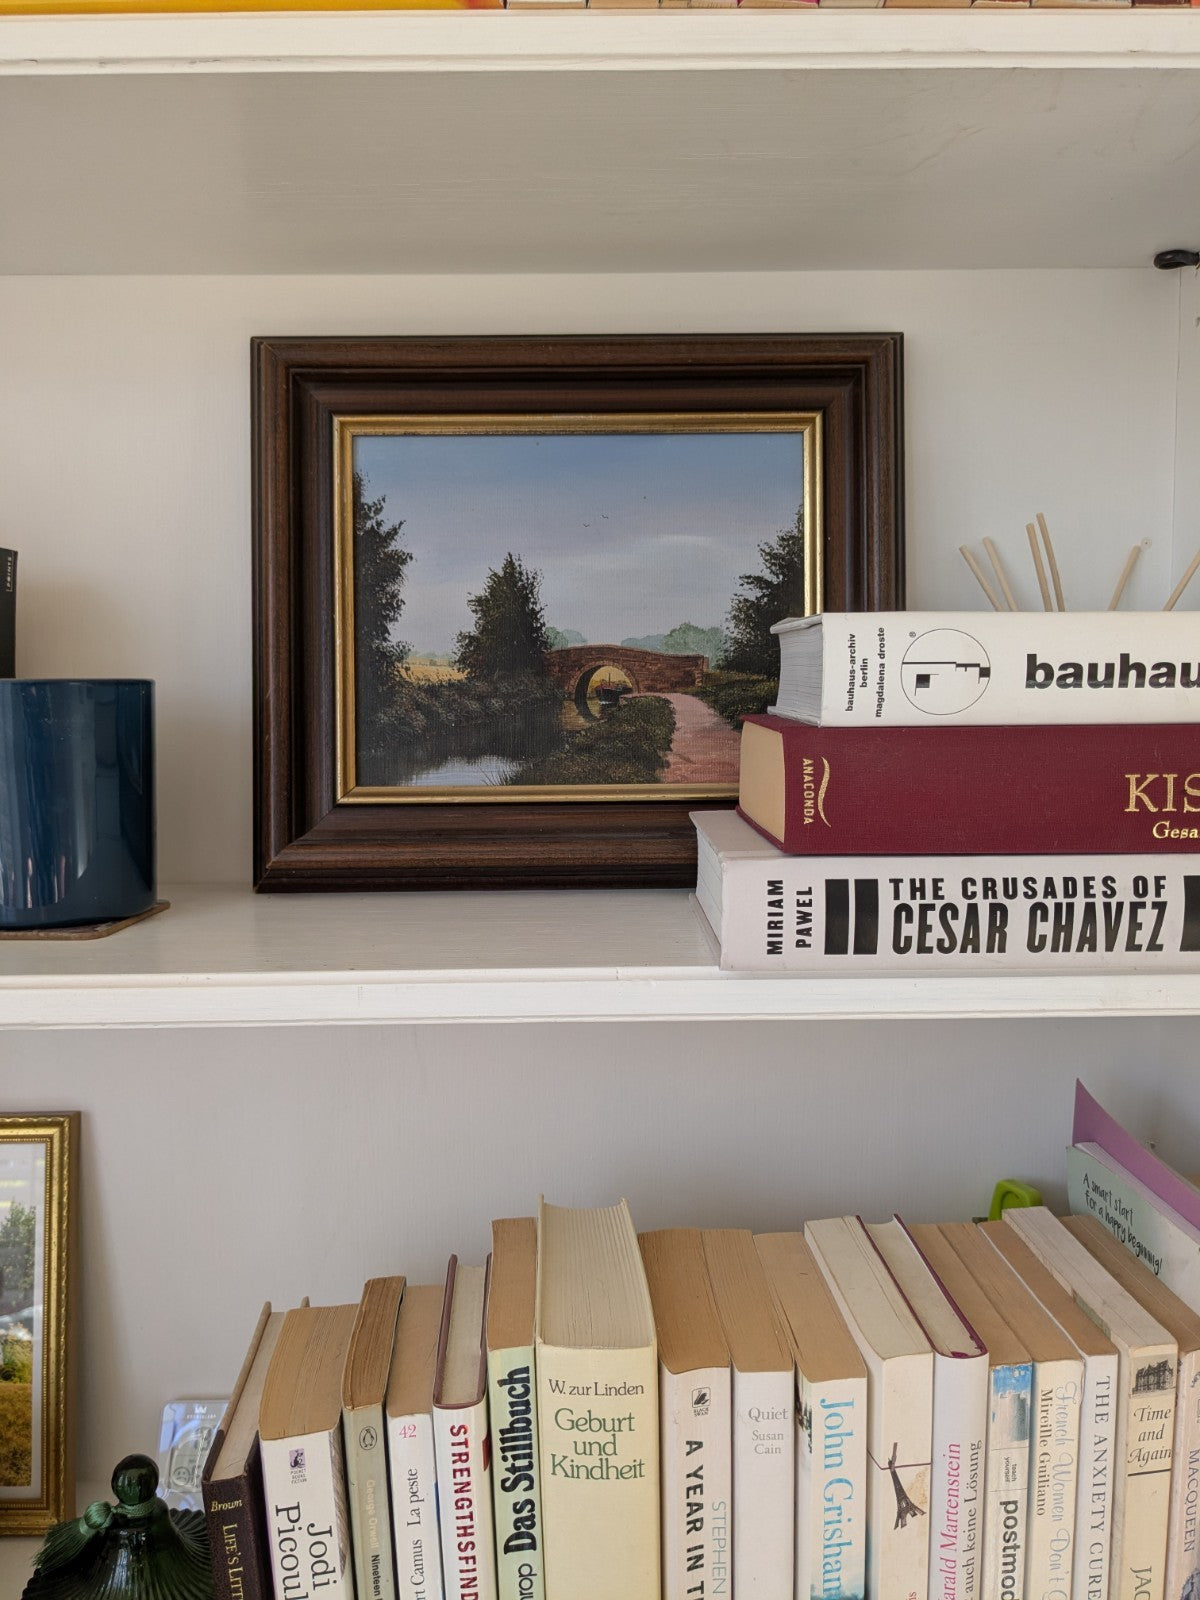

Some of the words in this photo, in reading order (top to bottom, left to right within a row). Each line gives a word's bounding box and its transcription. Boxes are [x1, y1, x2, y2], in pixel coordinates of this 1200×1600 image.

[845, 633, 856, 712] bauhaus-archiv
[859, 657, 869, 688] berlin
[875, 663, 886, 718] magdalena
[802, 757, 815, 825] ANACONDA
[1124, 773, 1200, 813] KIS
[889, 878, 945, 901] THE
[961, 875, 1117, 899] CRUSADES
[1132, 875, 1167, 898] OF
[766, 879, 784, 955] MIRIAM
[795, 886, 813, 949] PAWEL
[892, 902, 1009, 955] CESAR
[1026, 901, 1168, 953] CHAVEZ
[1083, 1172, 1090, 1188] A
[1091, 1181, 1112, 1208] smart
[1114, 1197, 1133, 1227] start
[1085, 1190, 1097, 1211] for
[1098, 1207, 1104, 1219] a
[1105, 1205, 1126, 1243] happy
[548, 1379, 566, 1395] W.
[568, 1385, 592, 1396] zur
[594, 1381, 644, 1396] Linden
[1094, 1375, 1111, 1424] THE
[399, 1424, 417, 1439] 42
[497, 1366, 535, 1493] Stillbuch
[554, 1407, 636, 1433] Geburt
[748, 1406, 789, 1422] Quiet
[752, 1429, 784, 1441] Susan
[819, 1398, 855, 1471] John
[1039, 1387, 1053, 1448] Mireille
[1055, 1381, 1077, 1446] French
[1133, 1404, 1172, 1422] Time
[1138, 1423, 1165, 1442] and
[550, 1453, 646, 1480] Kindheit
[573, 1433, 618, 1456] und
[685, 1440, 704, 1457] A
[754, 1443, 782, 1455] Cain
[1127, 1446, 1173, 1468] Again
[407, 1468, 425, 1504] peste
[964, 1440, 982, 1503] Lösung
[1036, 1451, 1051, 1516] Guiliano
[1051, 1451, 1074, 1522] Women
[1090, 1434, 1108, 1532] ANXIETY
[210, 1499, 243, 1512] Brown
[366, 1480, 376, 1515] George
[407, 1508, 421, 1527] La
[686, 1464, 704, 1535] YEAR
[939, 1443, 961, 1552] Martenstein
[1183, 1449, 1200, 1553] MACQUEEN
[369, 1517, 379, 1549] Orwell
[503, 1498, 537, 1555] Das
[712, 1501, 727, 1594] STEPHEN
[962, 1508, 977, 1553] keine
[307, 1522, 337, 1591] Jodi
[371, 1554, 380, 1597] Nineteen
[410, 1539, 425, 1586] Camus
[686, 1544, 704, 1573] IN
[961, 1556, 975, 1593] auch
[1048, 1528, 1070, 1584] Don't
[1088, 1542, 1104, 1600] CURE
